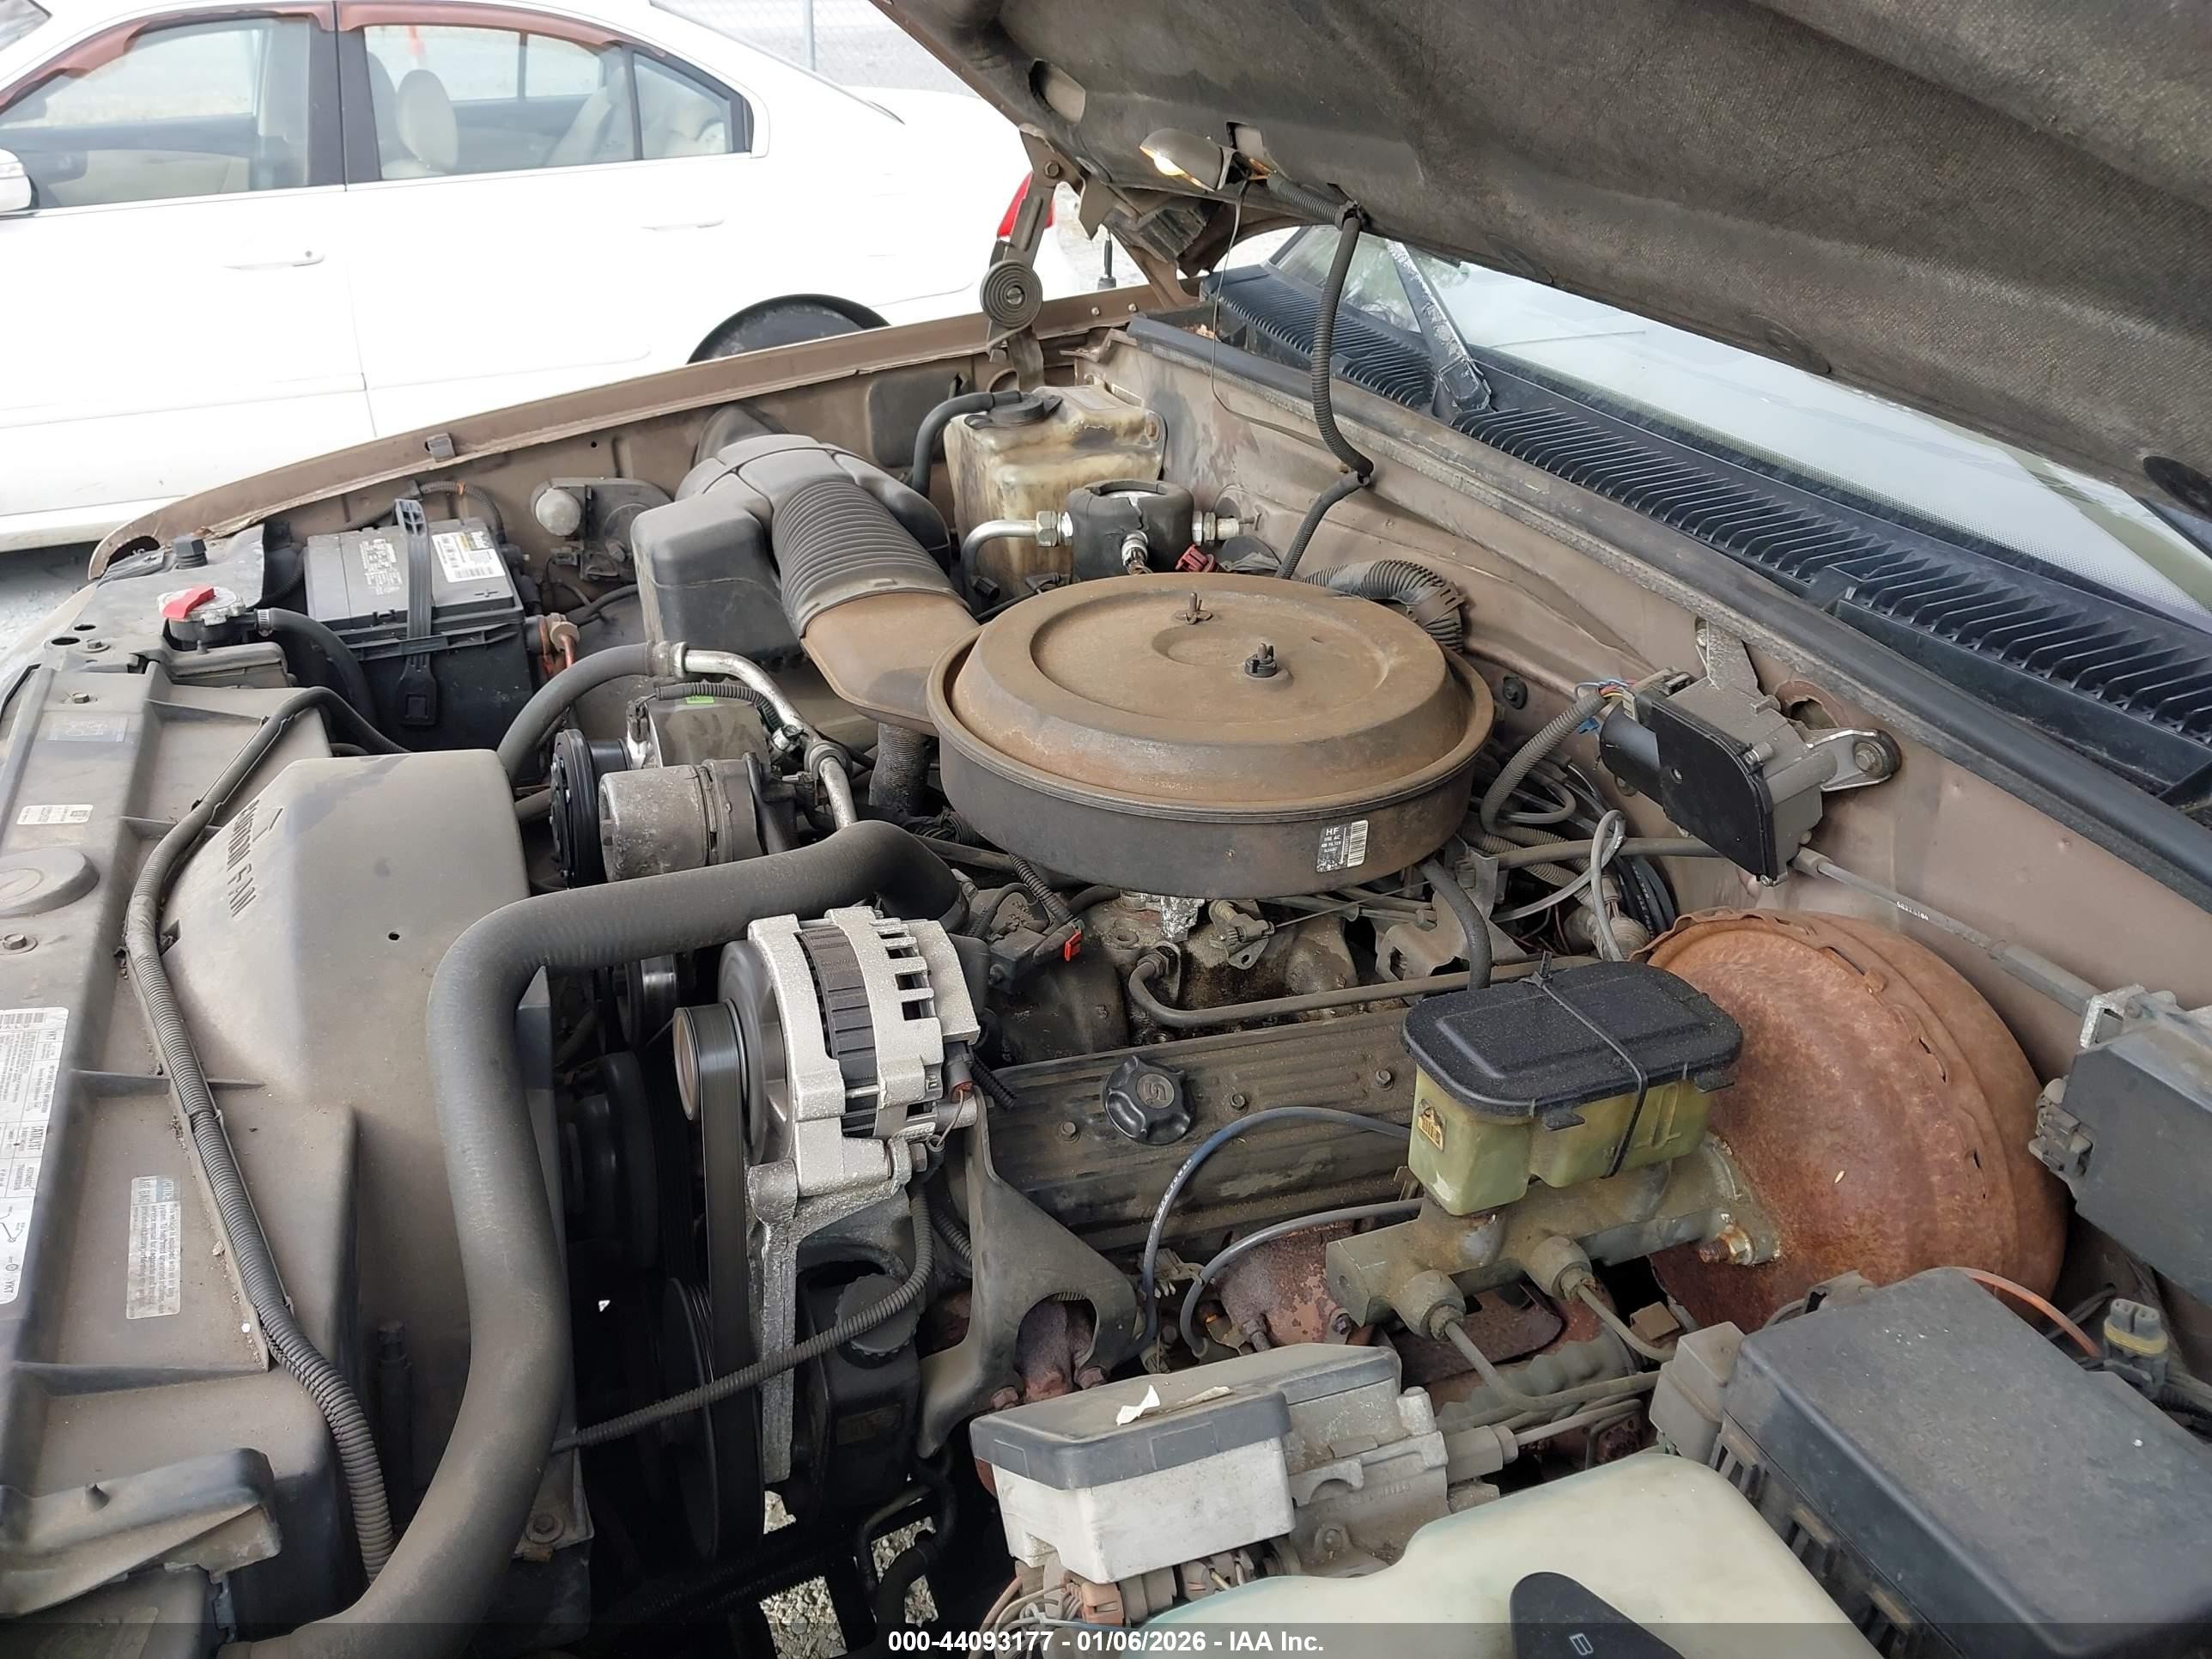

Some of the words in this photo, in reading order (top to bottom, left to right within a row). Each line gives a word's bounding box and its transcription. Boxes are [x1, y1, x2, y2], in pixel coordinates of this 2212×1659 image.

[228, 799, 260, 872] CAUTION
[1326, 827, 1339, 836] HF
[228, 863, 257, 918] FAN
[46, 1030, 58, 1040] YKT
[27, 1126, 44, 1151] CATALYST
[137, 1179, 151, 1190] AIR
[137, 1191, 151, 1202] BAG
[3, 1280, 15, 1293] YKT
